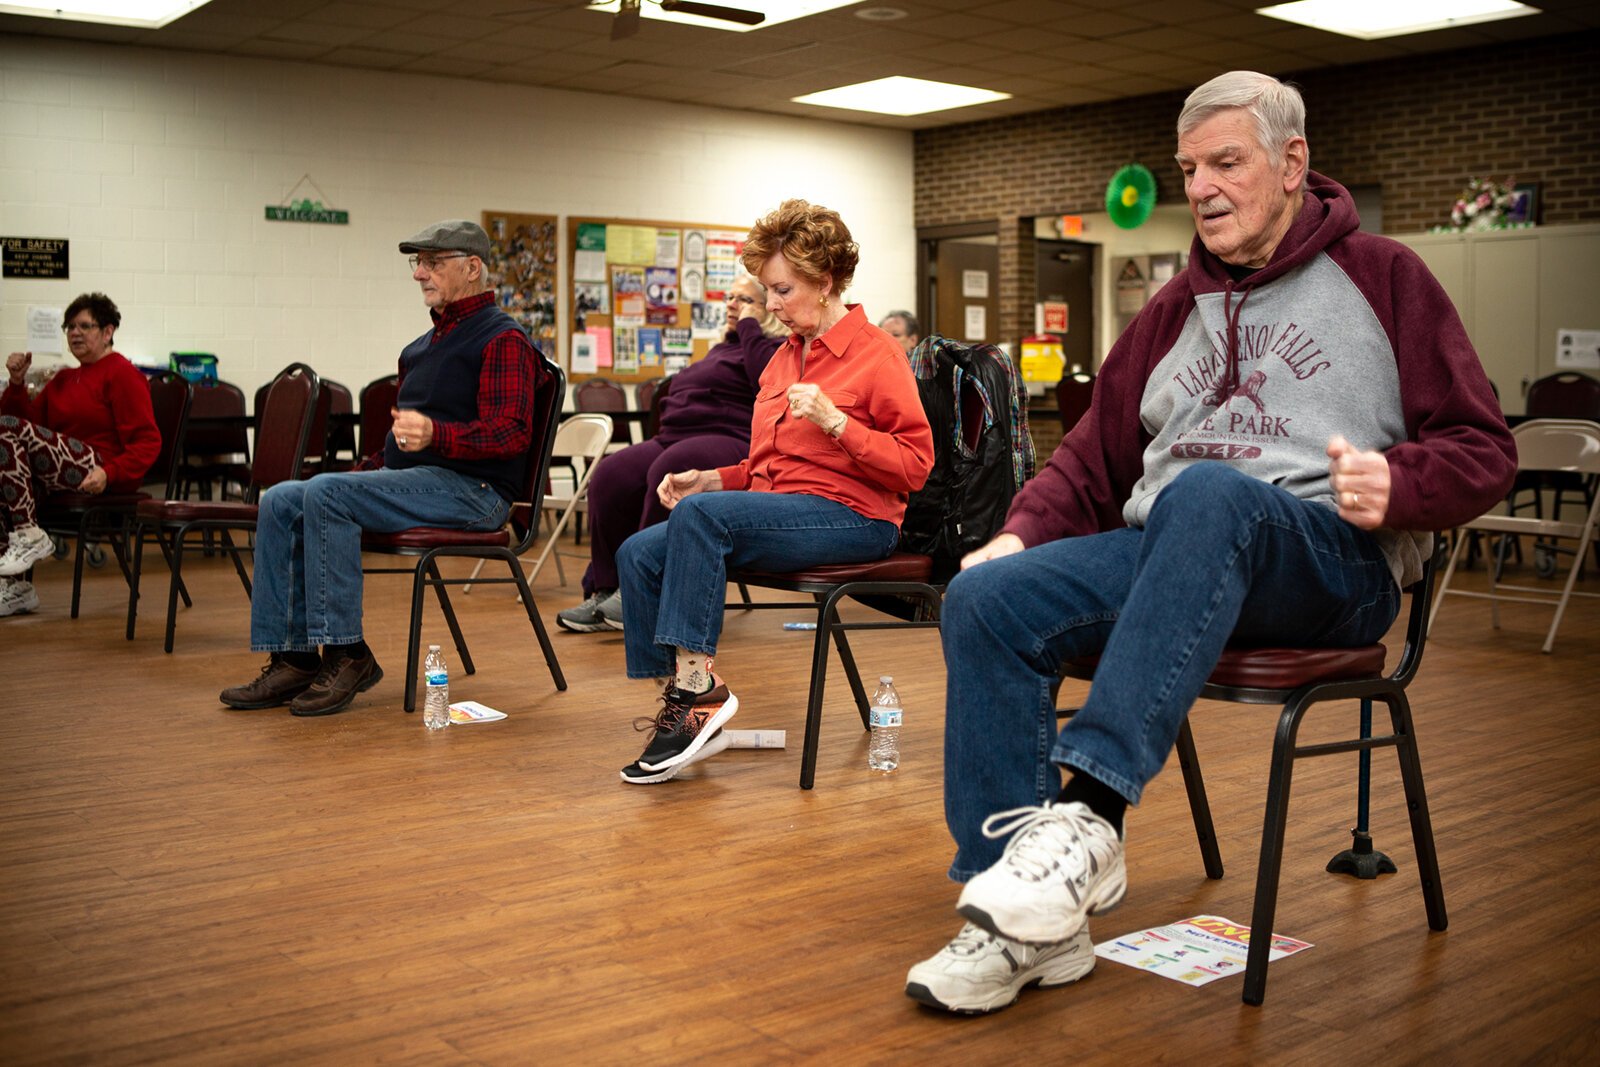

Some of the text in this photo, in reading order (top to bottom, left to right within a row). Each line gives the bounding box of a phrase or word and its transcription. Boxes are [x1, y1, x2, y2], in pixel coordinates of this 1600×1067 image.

[2, 239, 64, 250] FOR SAFETY
[1271, 322, 1332, 381] FALLS
[1229, 412, 1293, 438] PARK
[1196, 432, 1249, 442] MOUNTAIN
[1179, 444, 1251, 459] 1947
[1184, 928, 1250, 951] MOVEMEN
